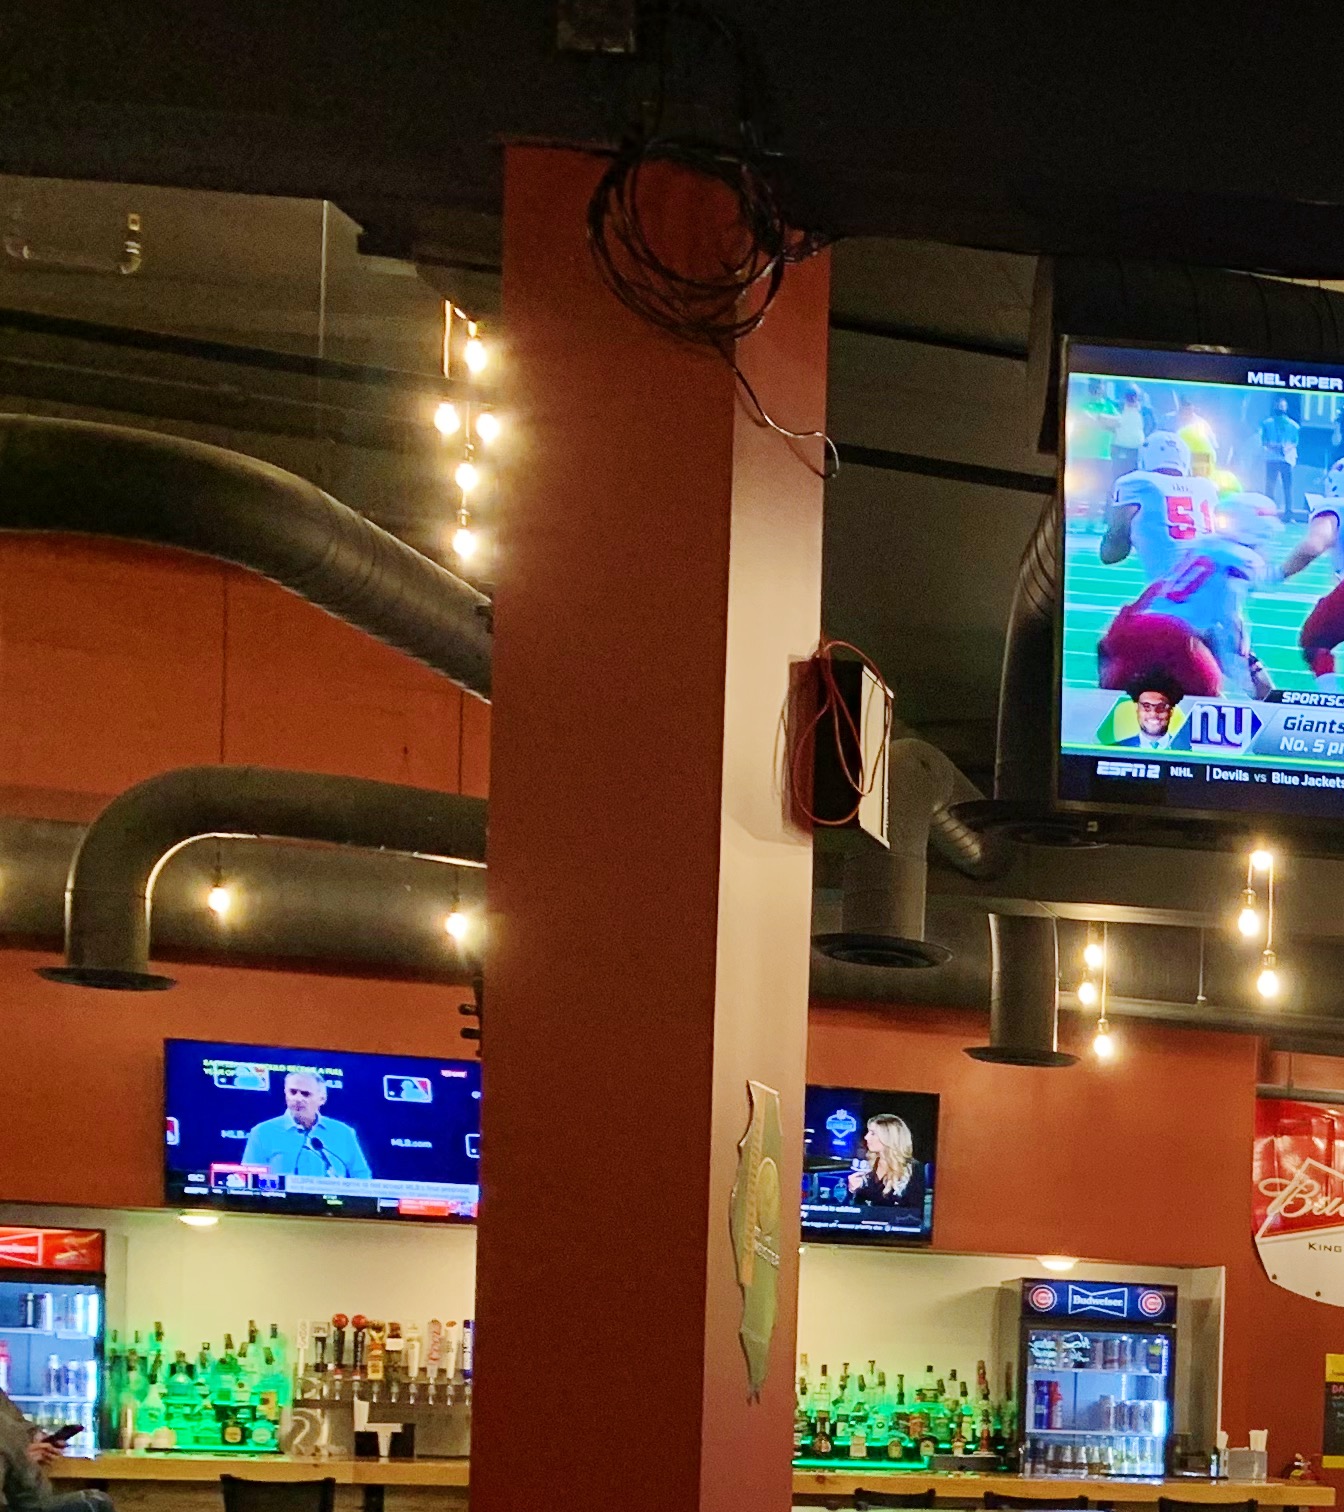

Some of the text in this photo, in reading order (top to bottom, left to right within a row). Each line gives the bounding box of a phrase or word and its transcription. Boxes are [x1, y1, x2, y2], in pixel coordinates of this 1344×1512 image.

[1247, 371, 1285, 386] MEL
[1289, 374, 1343, 391] KIPER
[1279, 736, 1309, 752] No.
[1312, 738, 1324, 753] 5
[1169, 765, 1194, 778] NHL
[1212, 767, 1250, 782] Devils
[1253, 773, 1268, 783] vs
[1271, 771, 1300, 786] Blue
[1072, 1294, 1124, 1307] Budweiser
